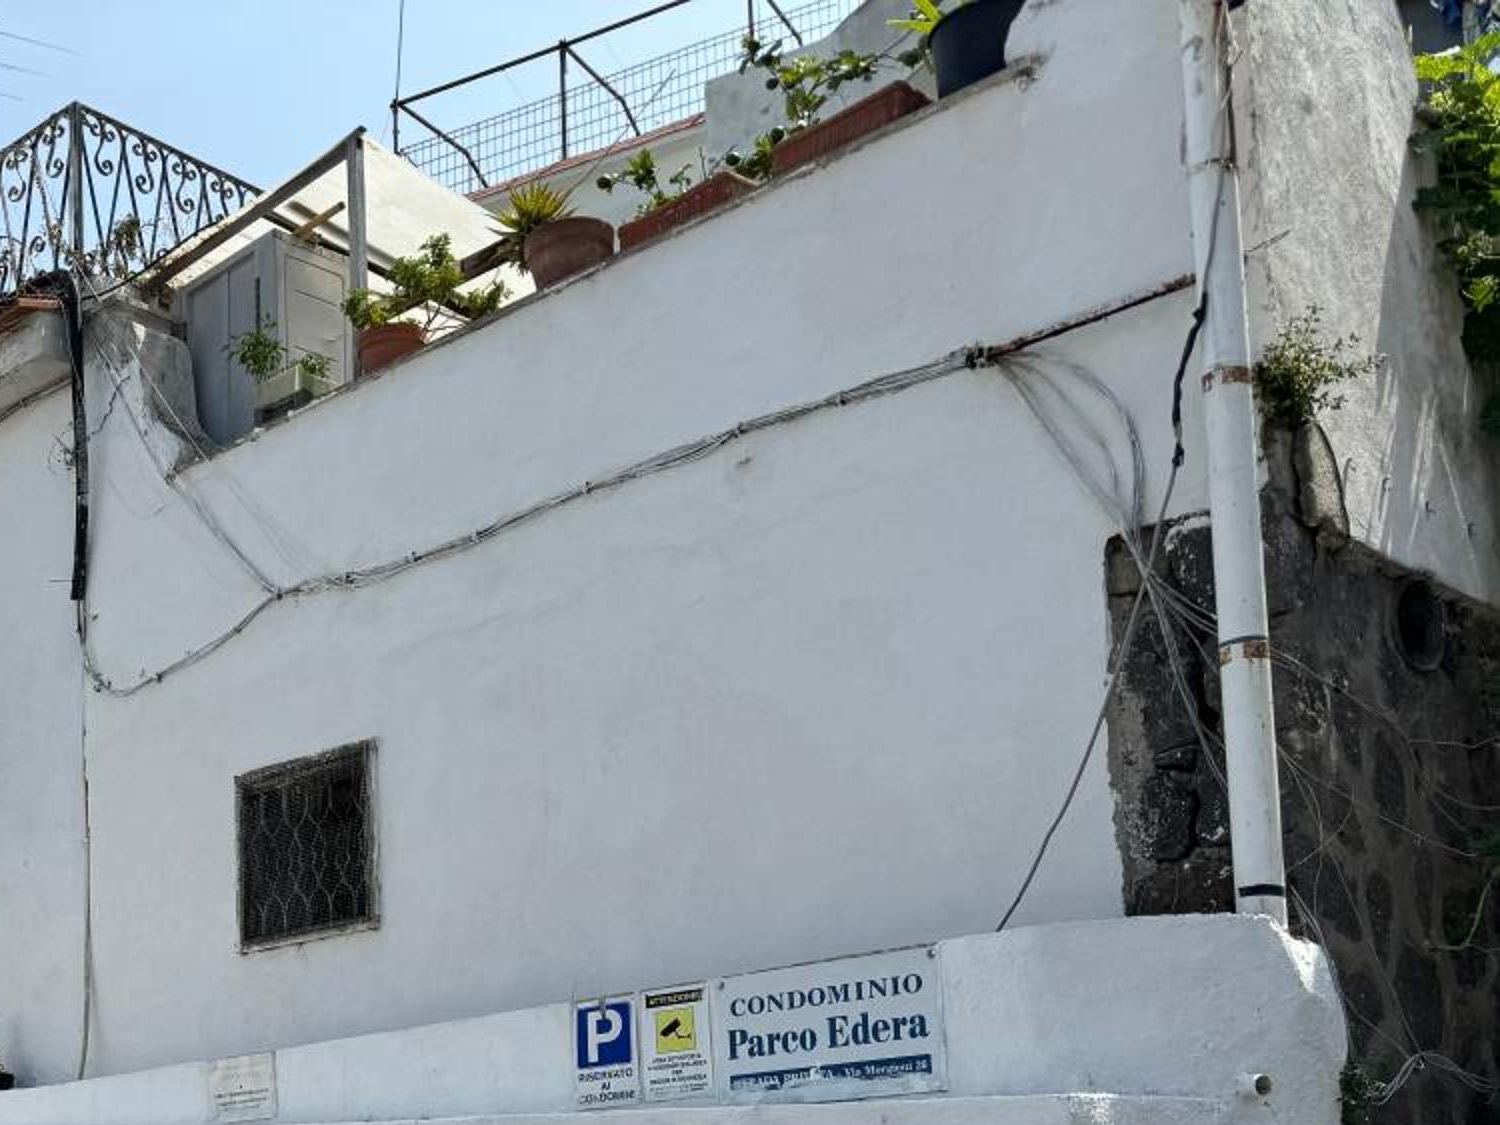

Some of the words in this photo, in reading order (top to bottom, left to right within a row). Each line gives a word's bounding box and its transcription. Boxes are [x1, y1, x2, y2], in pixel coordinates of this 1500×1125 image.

[730, 973, 923, 1017] CONDOMINIO
[587, 1009, 623, 1063] P
[727, 1029, 817, 1060] Parco
[825, 1012, 930, 1049] Edera
